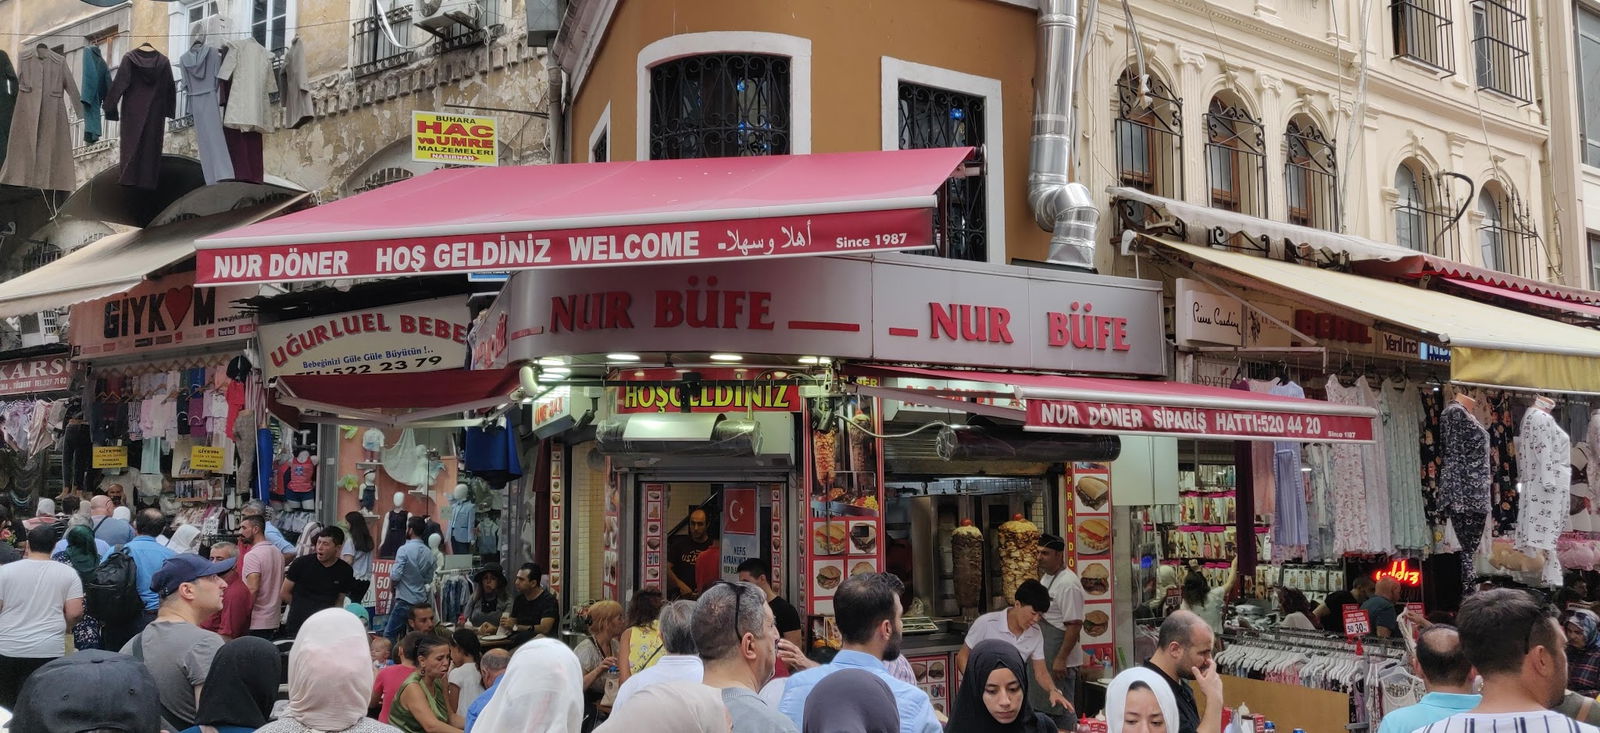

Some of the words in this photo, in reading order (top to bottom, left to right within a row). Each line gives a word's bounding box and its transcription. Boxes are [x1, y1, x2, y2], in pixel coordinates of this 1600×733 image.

[435, 115, 476, 124] BUHARA
[417, 120, 494, 138] HAC
[436, 136, 494, 149] UMRE
[836, 236, 870, 249] Since
[874, 233, 907, 246] 1987
[213, 249, 261, 279] NUR
[268, 248, 349, 277] DÖNER
[375, 246, 427, 276] HOŞ
[433, 234, 551, 270] GELDİNİZ
[568, 231, 699, 261] WELCOME
[548, 290, 635, 333] NUR
[654, 275, 776, 332] BÜFE
[929, 302, 1015, 344] NUR
[1047, 302, 1131, 352] BÜFE
[270, 313, 392, 368] UĞURLUEL
[399, 314, 468, 345] BEBE
[302, 358, 341, 369] Bebeğinizi
[343, 354, 362, 364] Güle
[364, 352, 383, 362] Güle
[385, 347, 422, 359] Büyütün
[380, 361, 407, 371] 23
[415, 356, 442, 368] 79
[1041, 403, 1079, 425] NUR
[1088, 404, 1142, 428] DÖNER
[1153, 406, 1207, 433] SİPARİŞ
[1286, 417, 1302, 433] 44
[1306, 417, 1321, 434] 20
[376, 577, 390, 589] 50
[1355, 623, 1364, 633] 30
